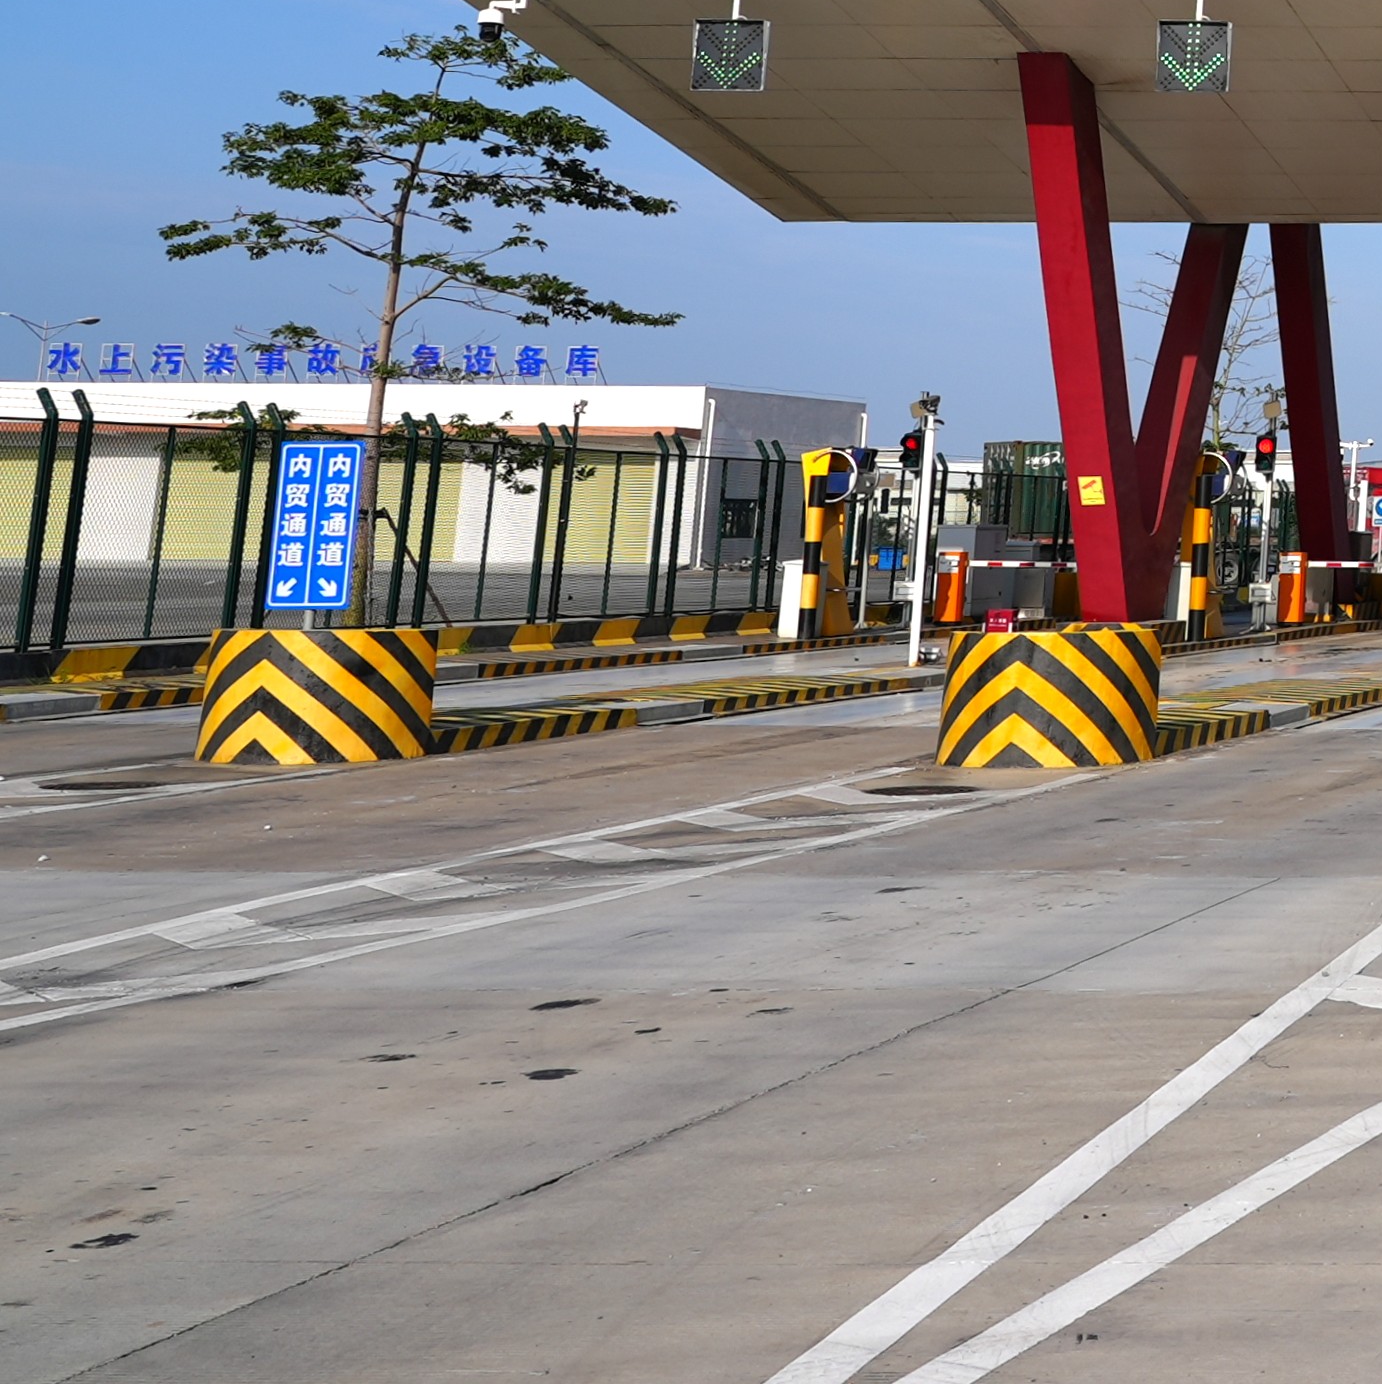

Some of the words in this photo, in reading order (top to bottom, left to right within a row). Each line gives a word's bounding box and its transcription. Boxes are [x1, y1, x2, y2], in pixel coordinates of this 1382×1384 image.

[277, 453, 313, 567] 内贸通道
[316, 453, 352, 567] 内贸通道
